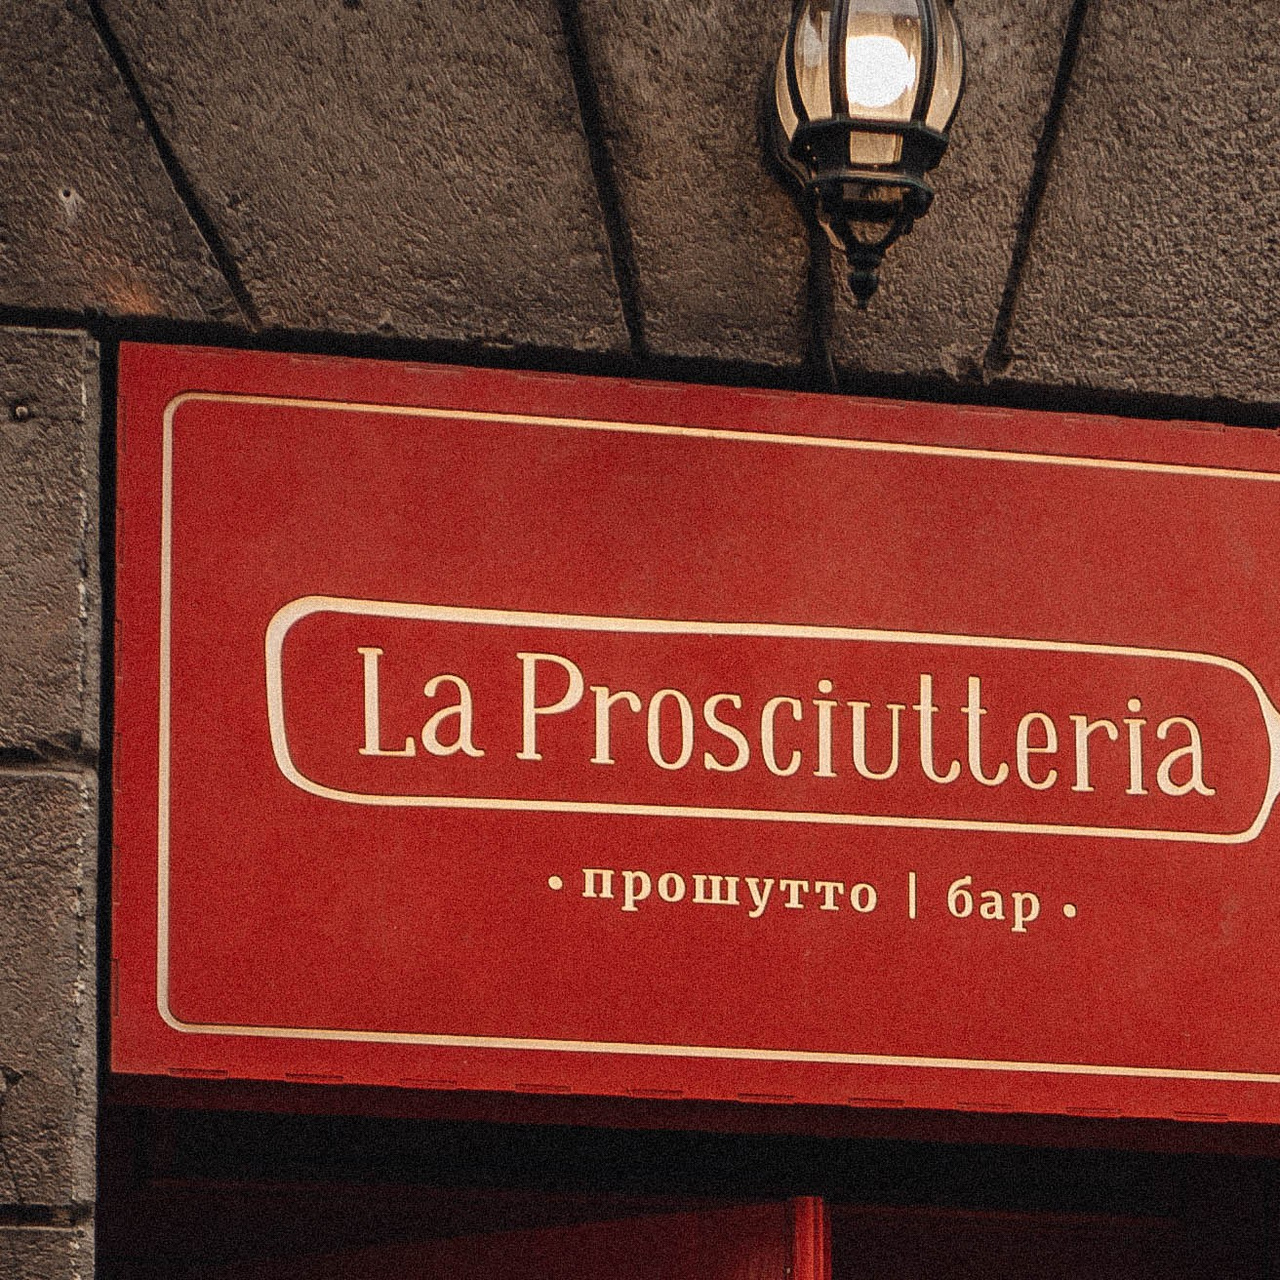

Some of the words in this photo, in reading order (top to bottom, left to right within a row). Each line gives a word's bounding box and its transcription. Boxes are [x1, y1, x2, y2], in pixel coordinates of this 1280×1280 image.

[356, 646, 486, 759] La
[515, 651, 1217, 798] Prosciutteria
[581, 867, 879, 919] прошутто
[946, 874, 1042, 934] бар
